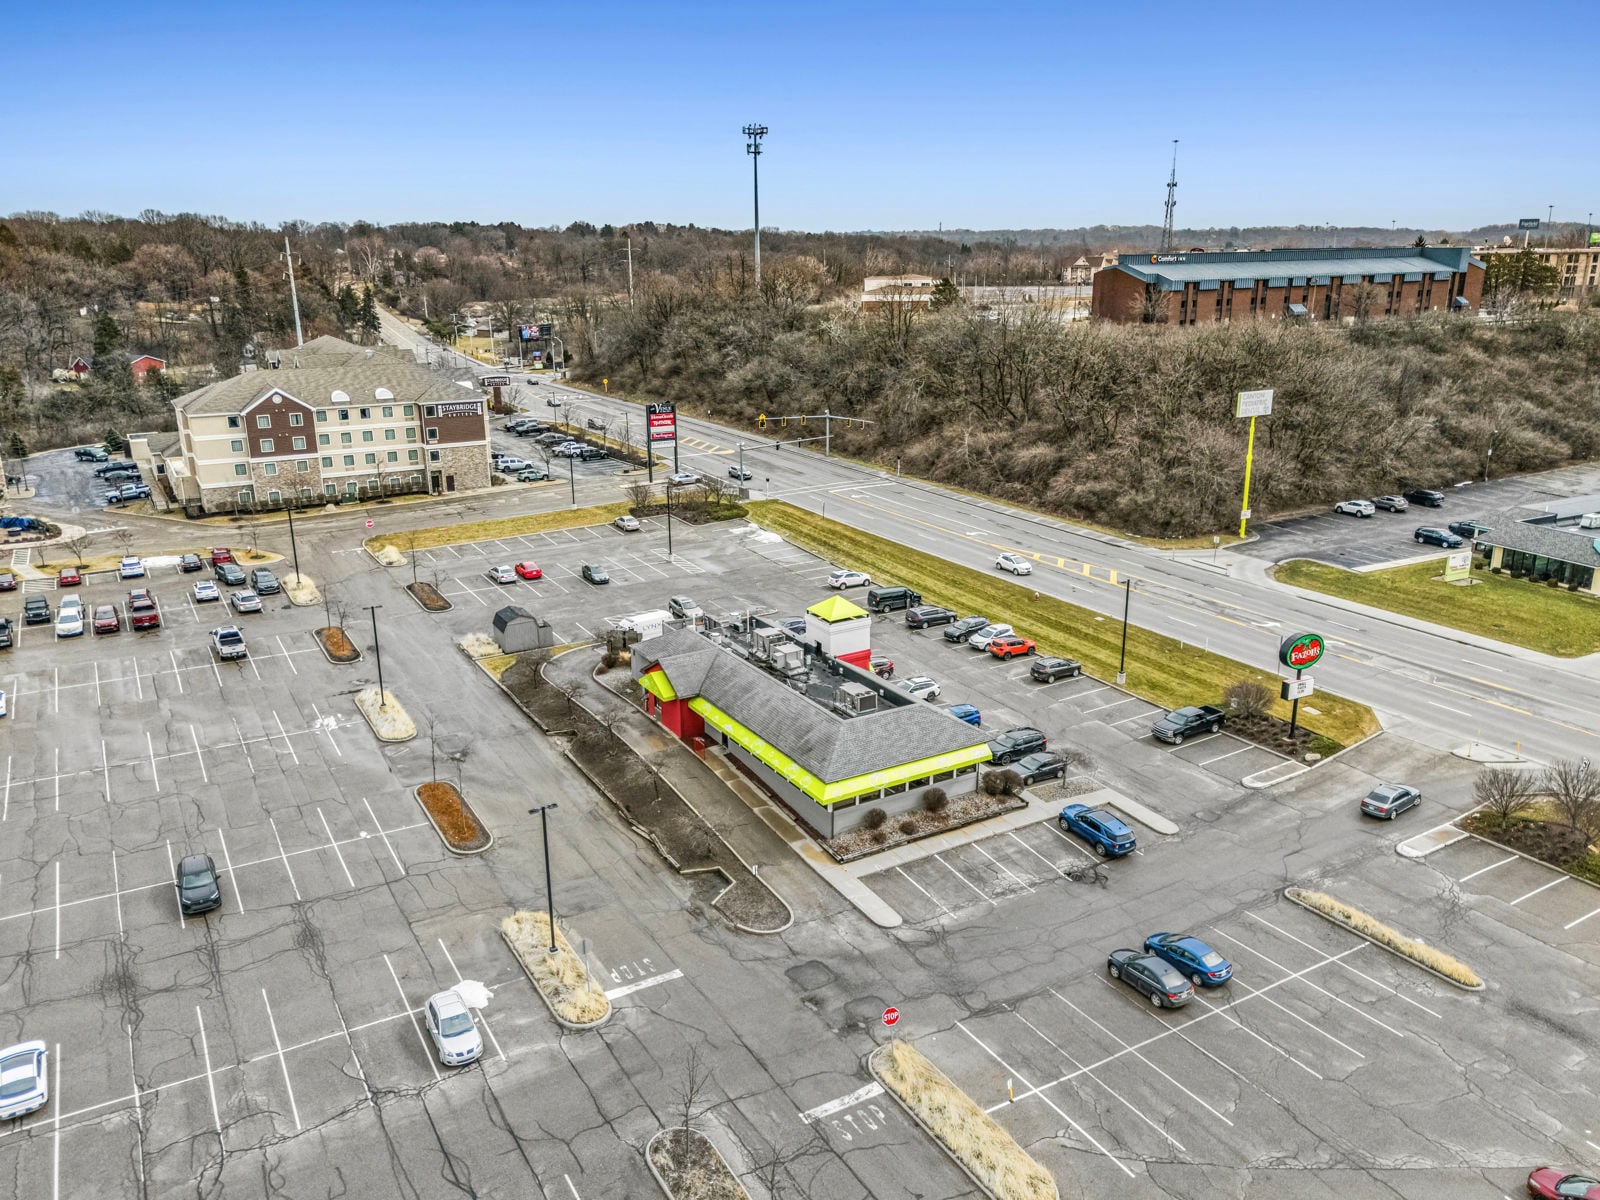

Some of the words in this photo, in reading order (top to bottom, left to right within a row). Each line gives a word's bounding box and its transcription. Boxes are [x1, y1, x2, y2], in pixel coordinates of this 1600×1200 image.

[442, 403, 477, 412] STAYBRIDGE
[884, 1011, 899, 1022] STOP
[831, 1105, 887, 1141] STOP
